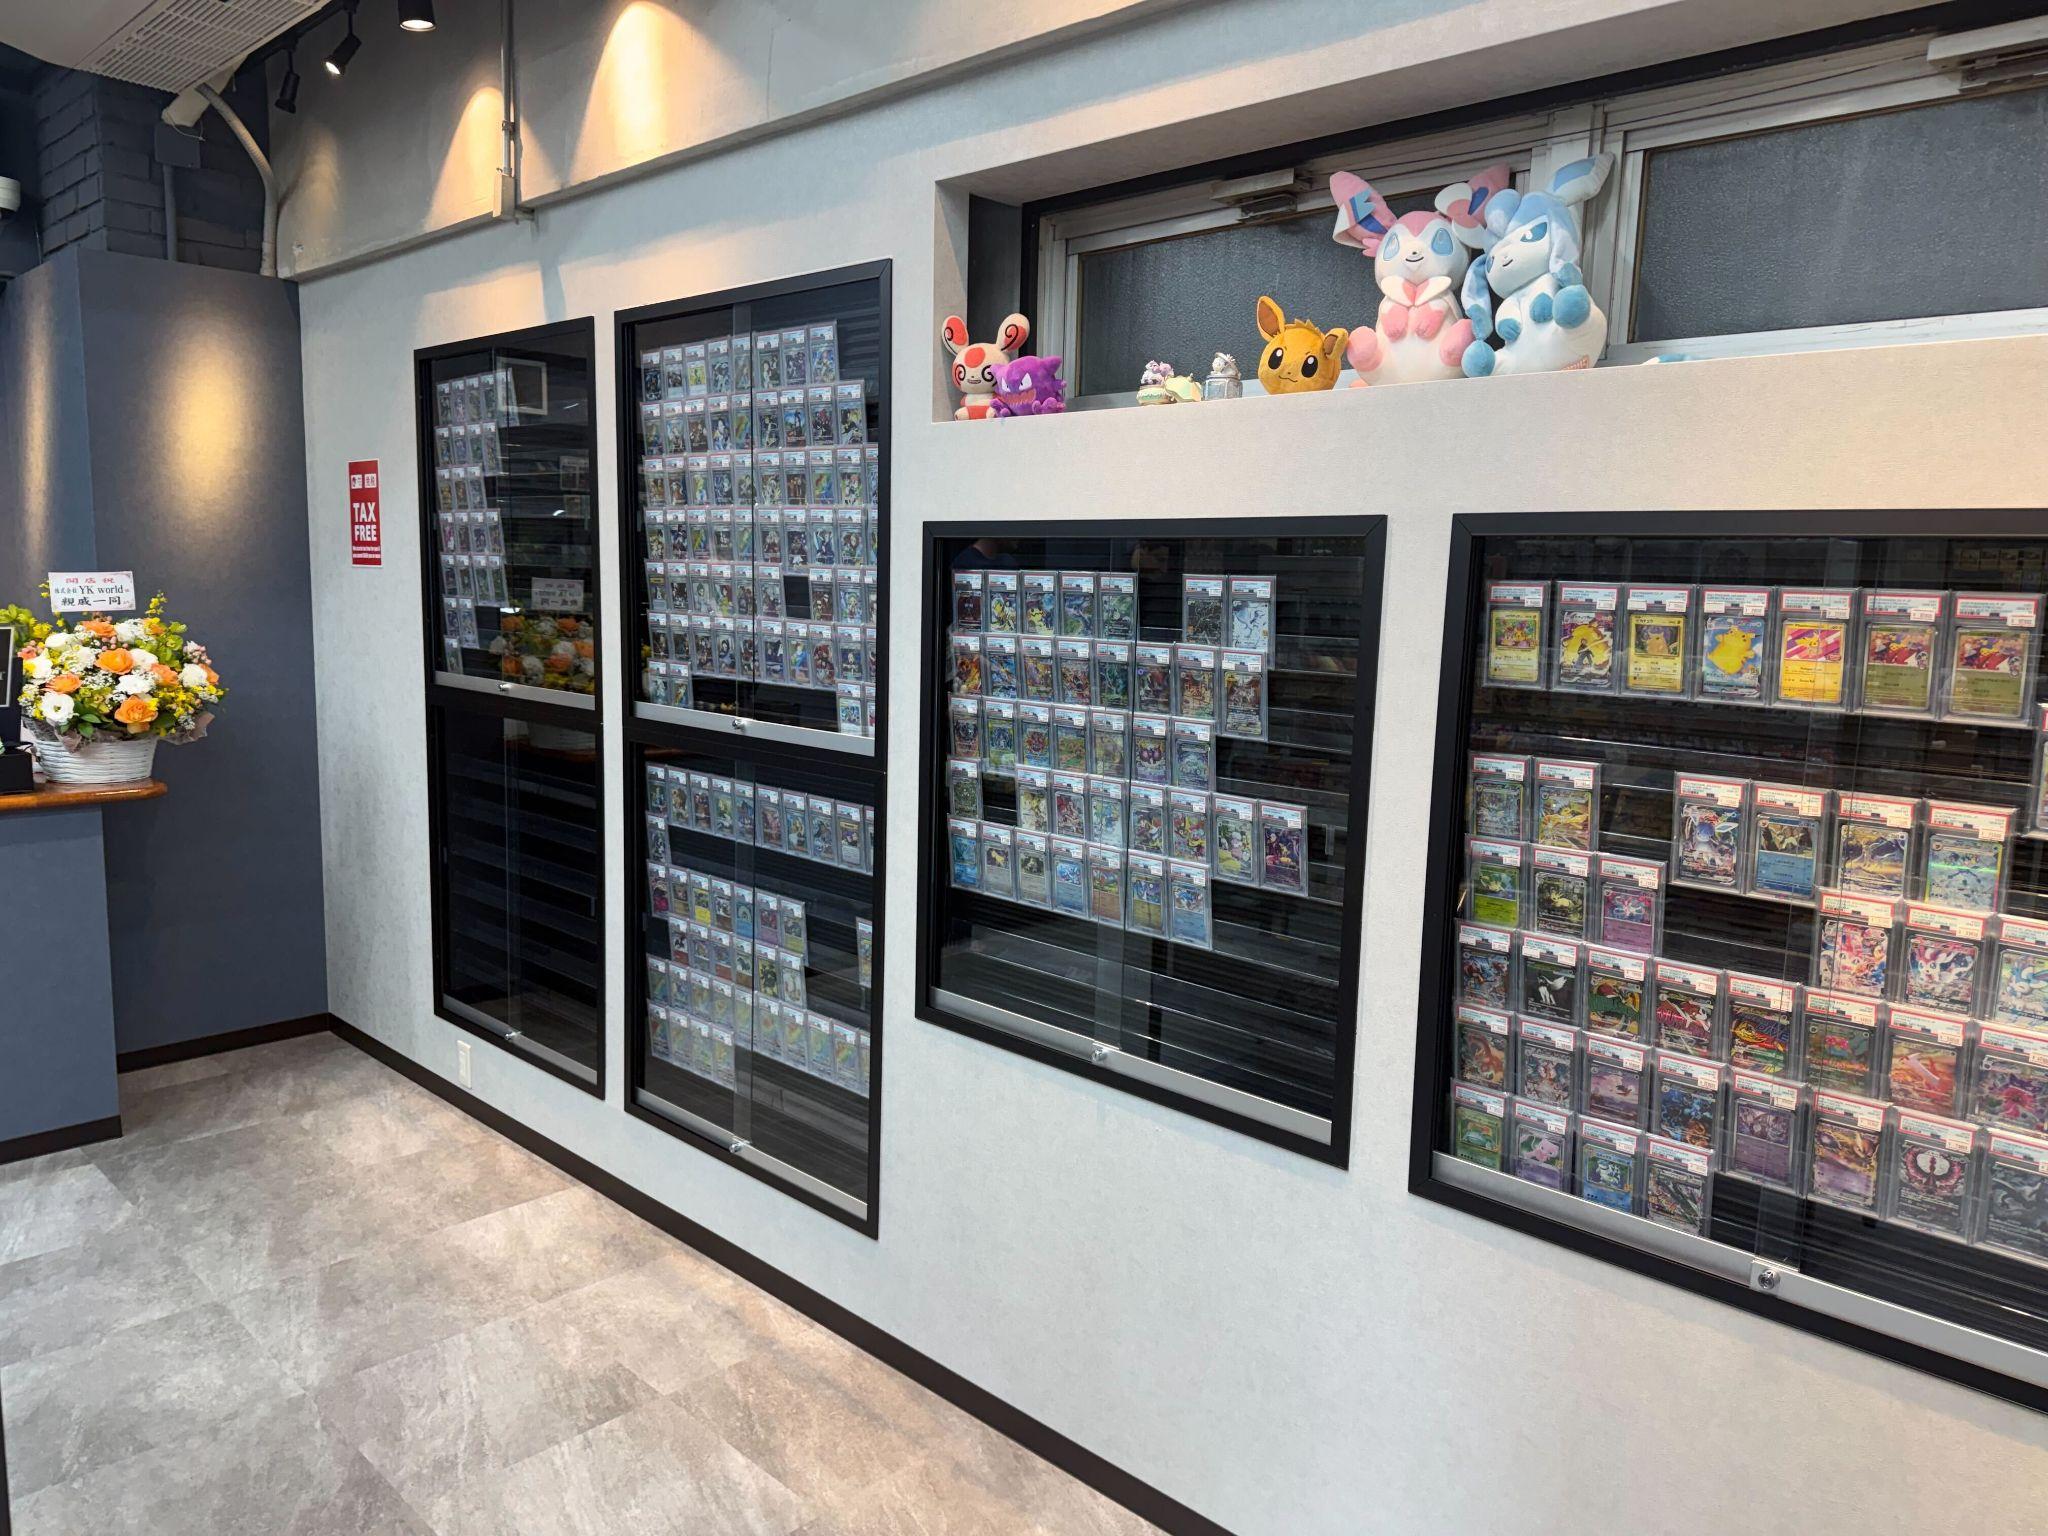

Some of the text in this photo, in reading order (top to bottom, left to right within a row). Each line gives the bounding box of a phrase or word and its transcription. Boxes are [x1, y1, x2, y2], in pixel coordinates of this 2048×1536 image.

[353, 502, 377, 522] TAX
[354, 524, 377, 541] FREE
[79, 585, 95, 594] YK
[97, 584, 124, 594] world
